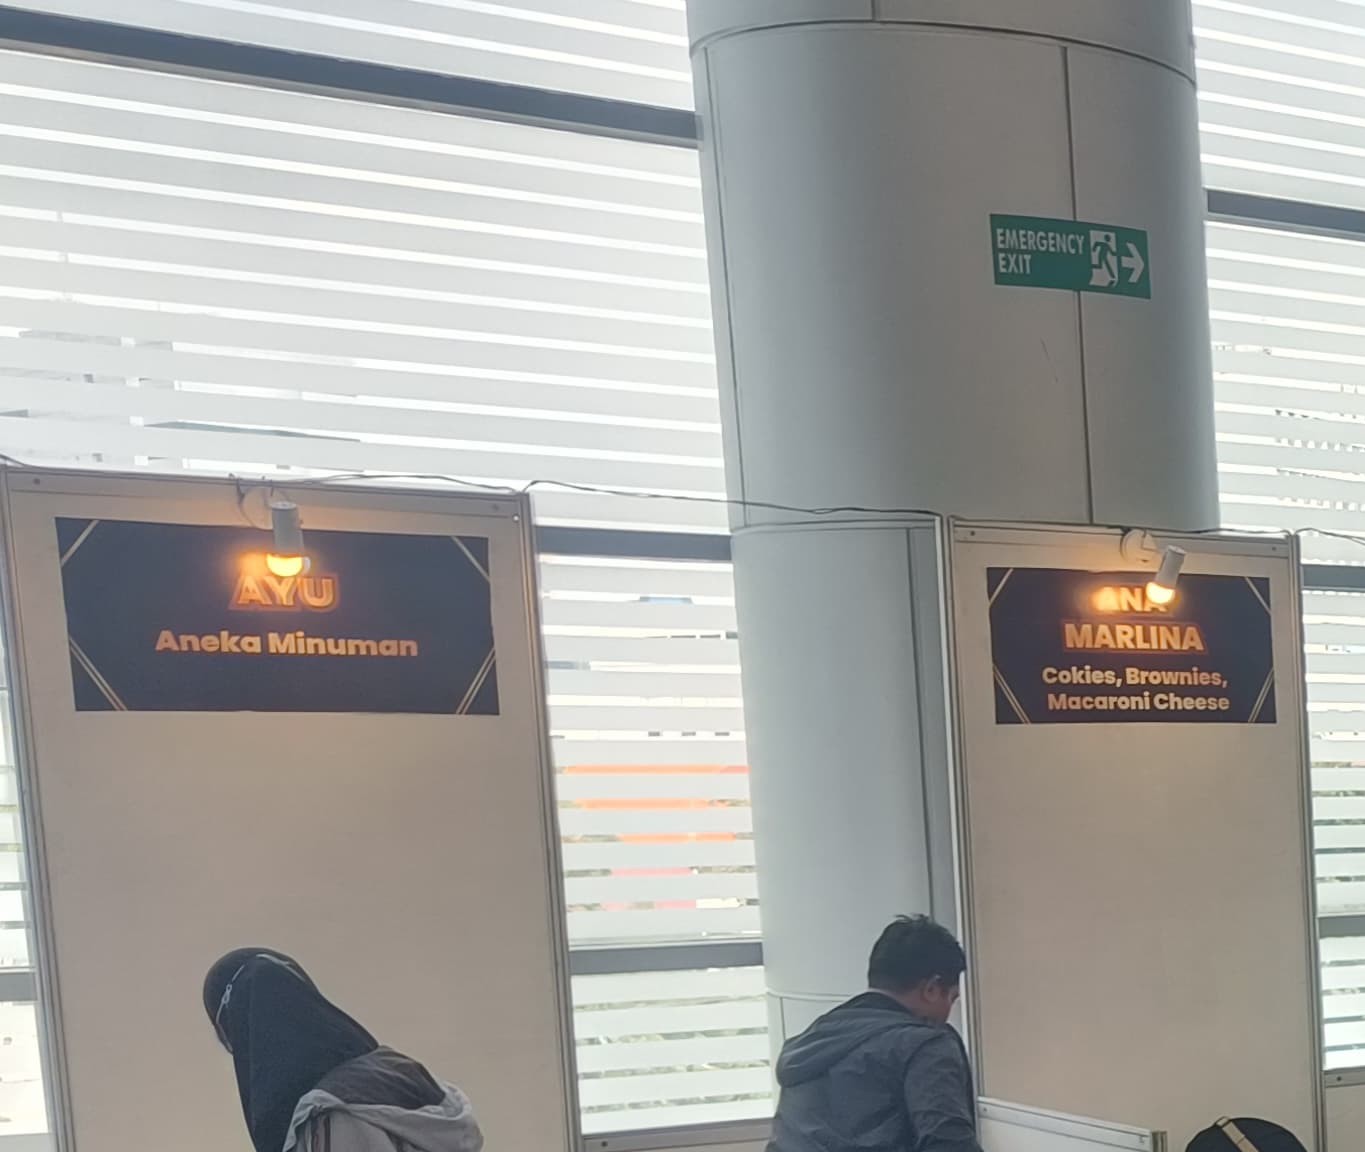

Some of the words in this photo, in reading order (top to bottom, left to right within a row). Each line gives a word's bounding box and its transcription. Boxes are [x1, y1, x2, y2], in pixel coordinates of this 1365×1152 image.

[996, 228, 1084, 255] EMERGENCY
[998, 252, 1032, 275] EXIT
[235, 574, 337, 609] AYU
[155, 629, 262, 654] Aneka
[267, 631, 419, 657] Minuman
[1063, 622, 1205, 651] MARLINA
[1041, 665, 1122, 688] Cokies,
[1124, 667, 1229, 688] Brownies,
[1047, 692, 1150, 711] Macaroni
[1153, 693, 1230, 711] Cheese
